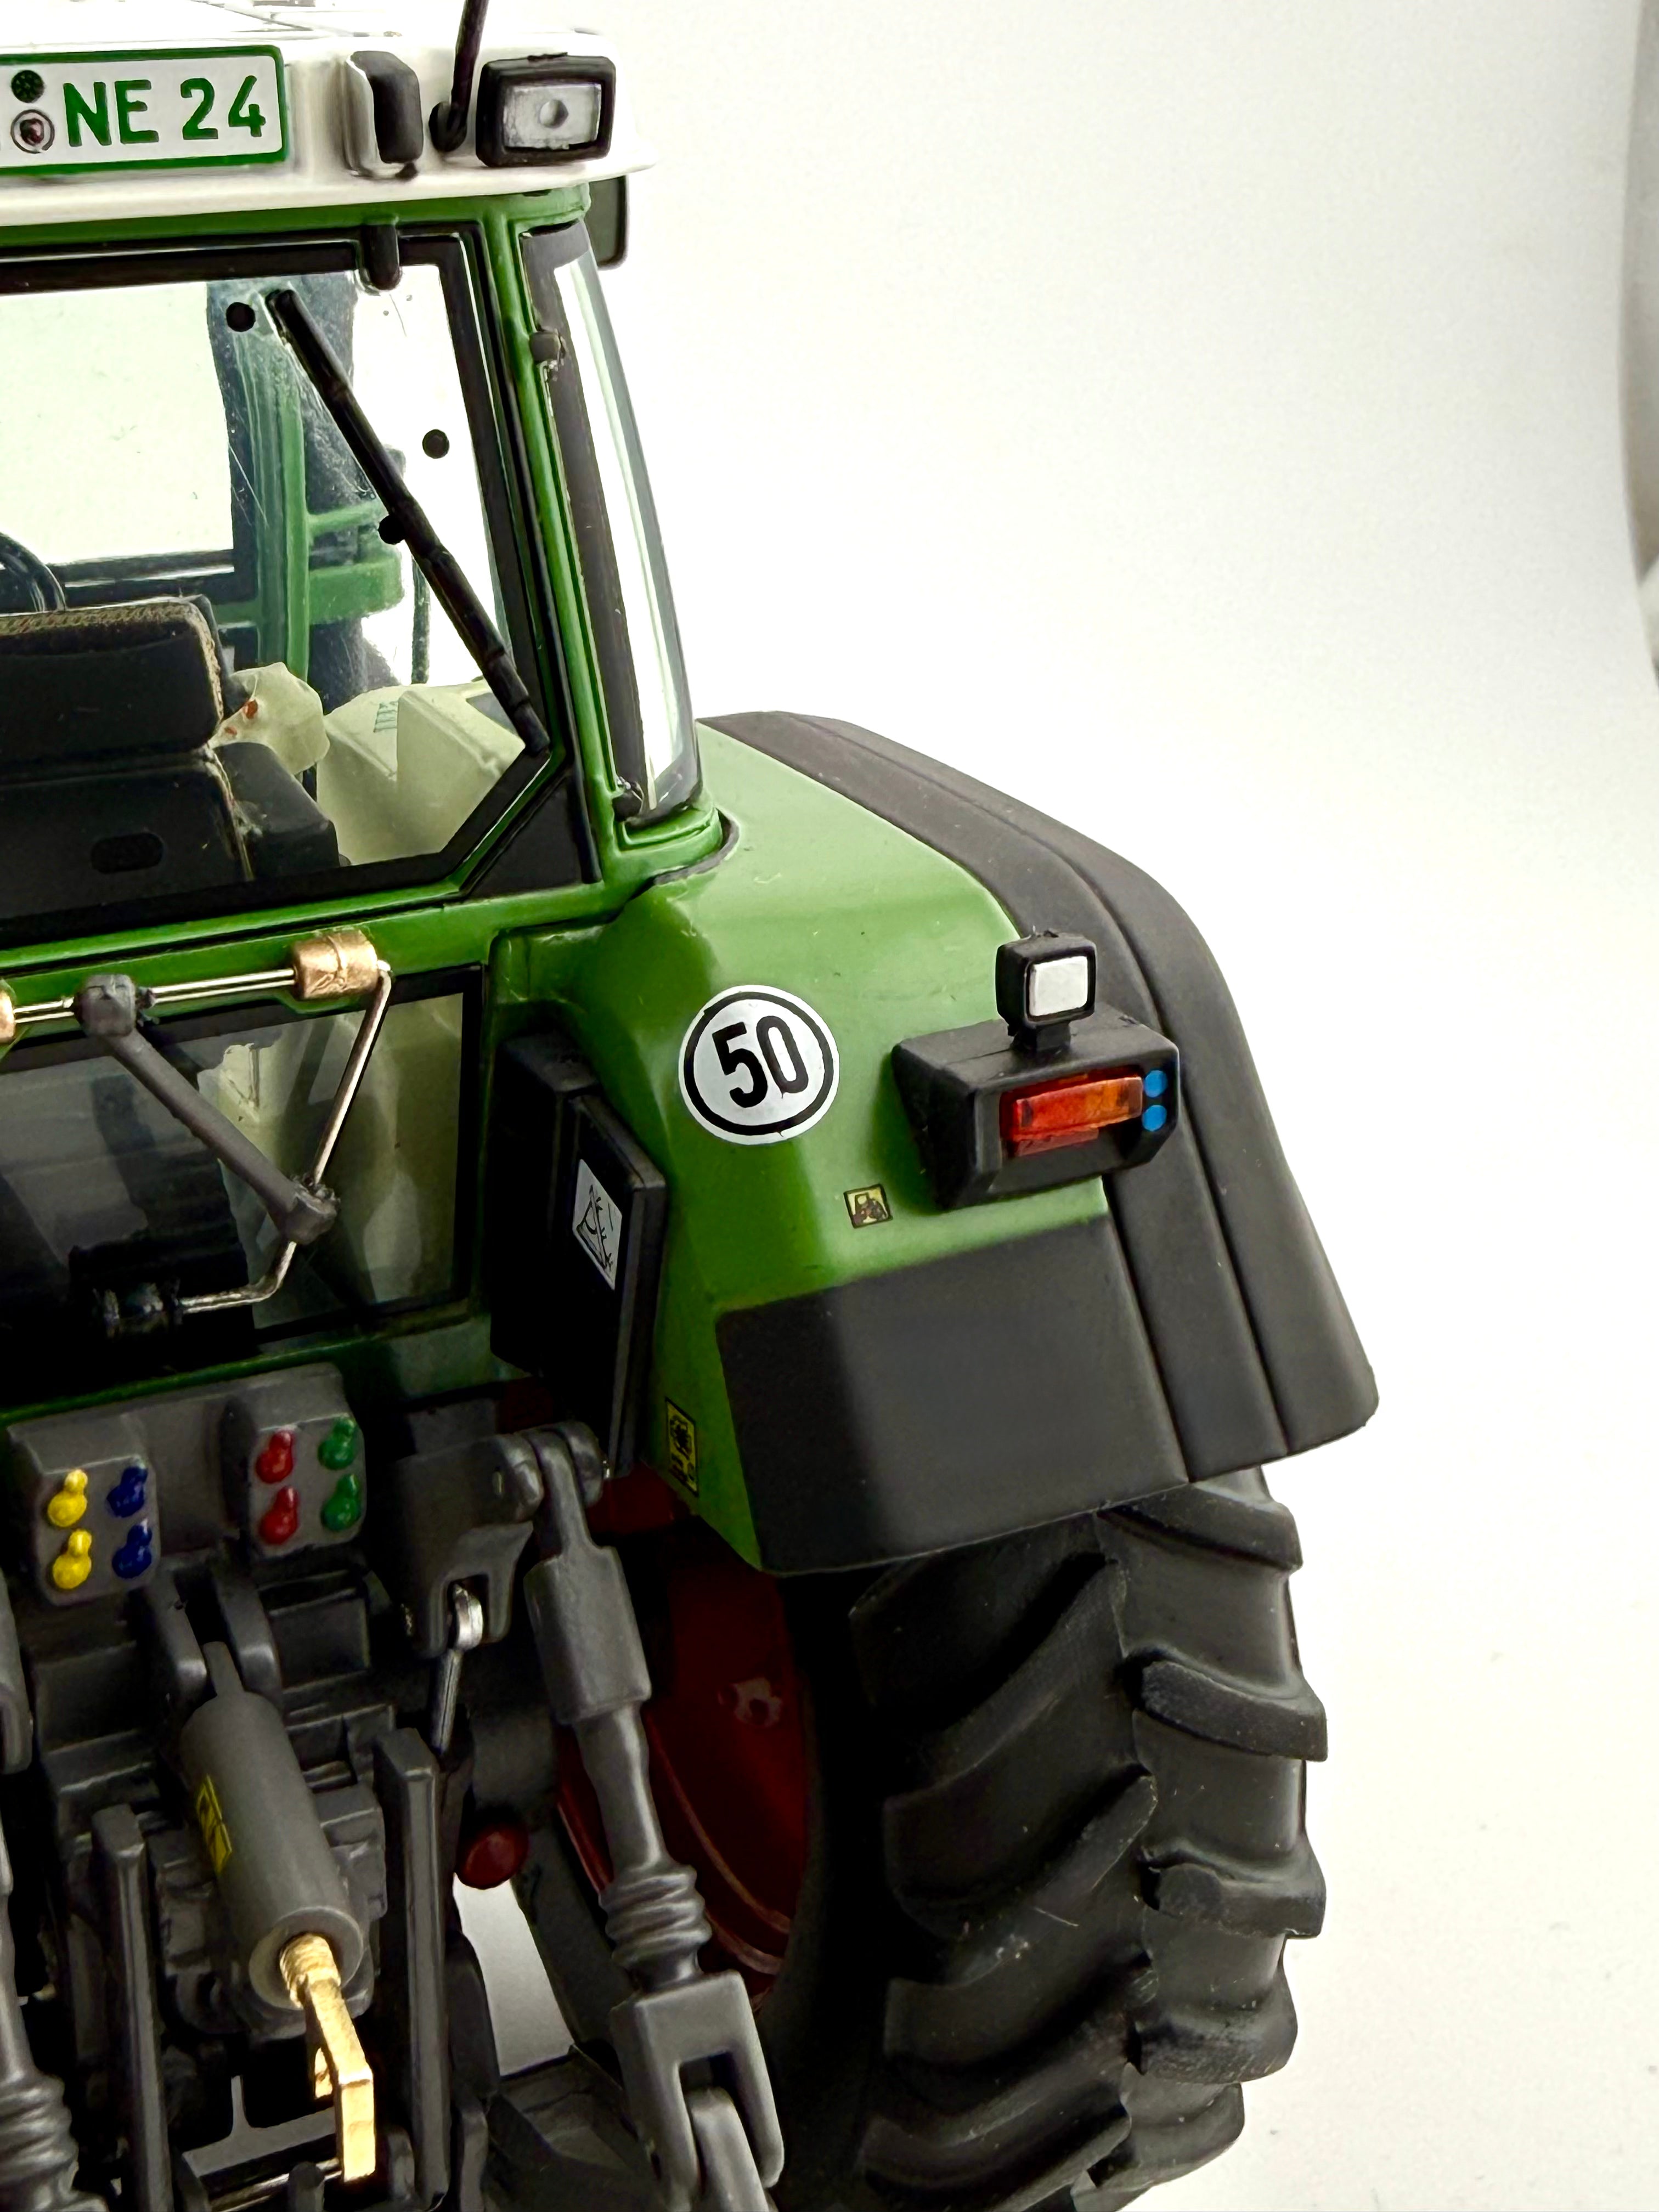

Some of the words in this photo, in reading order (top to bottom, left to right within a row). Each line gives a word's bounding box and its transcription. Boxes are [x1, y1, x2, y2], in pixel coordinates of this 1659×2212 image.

[63, 79, 159, 147] NE
[180, 75, 266, 140] 24
[712, 1015, 809, 1108] 50
